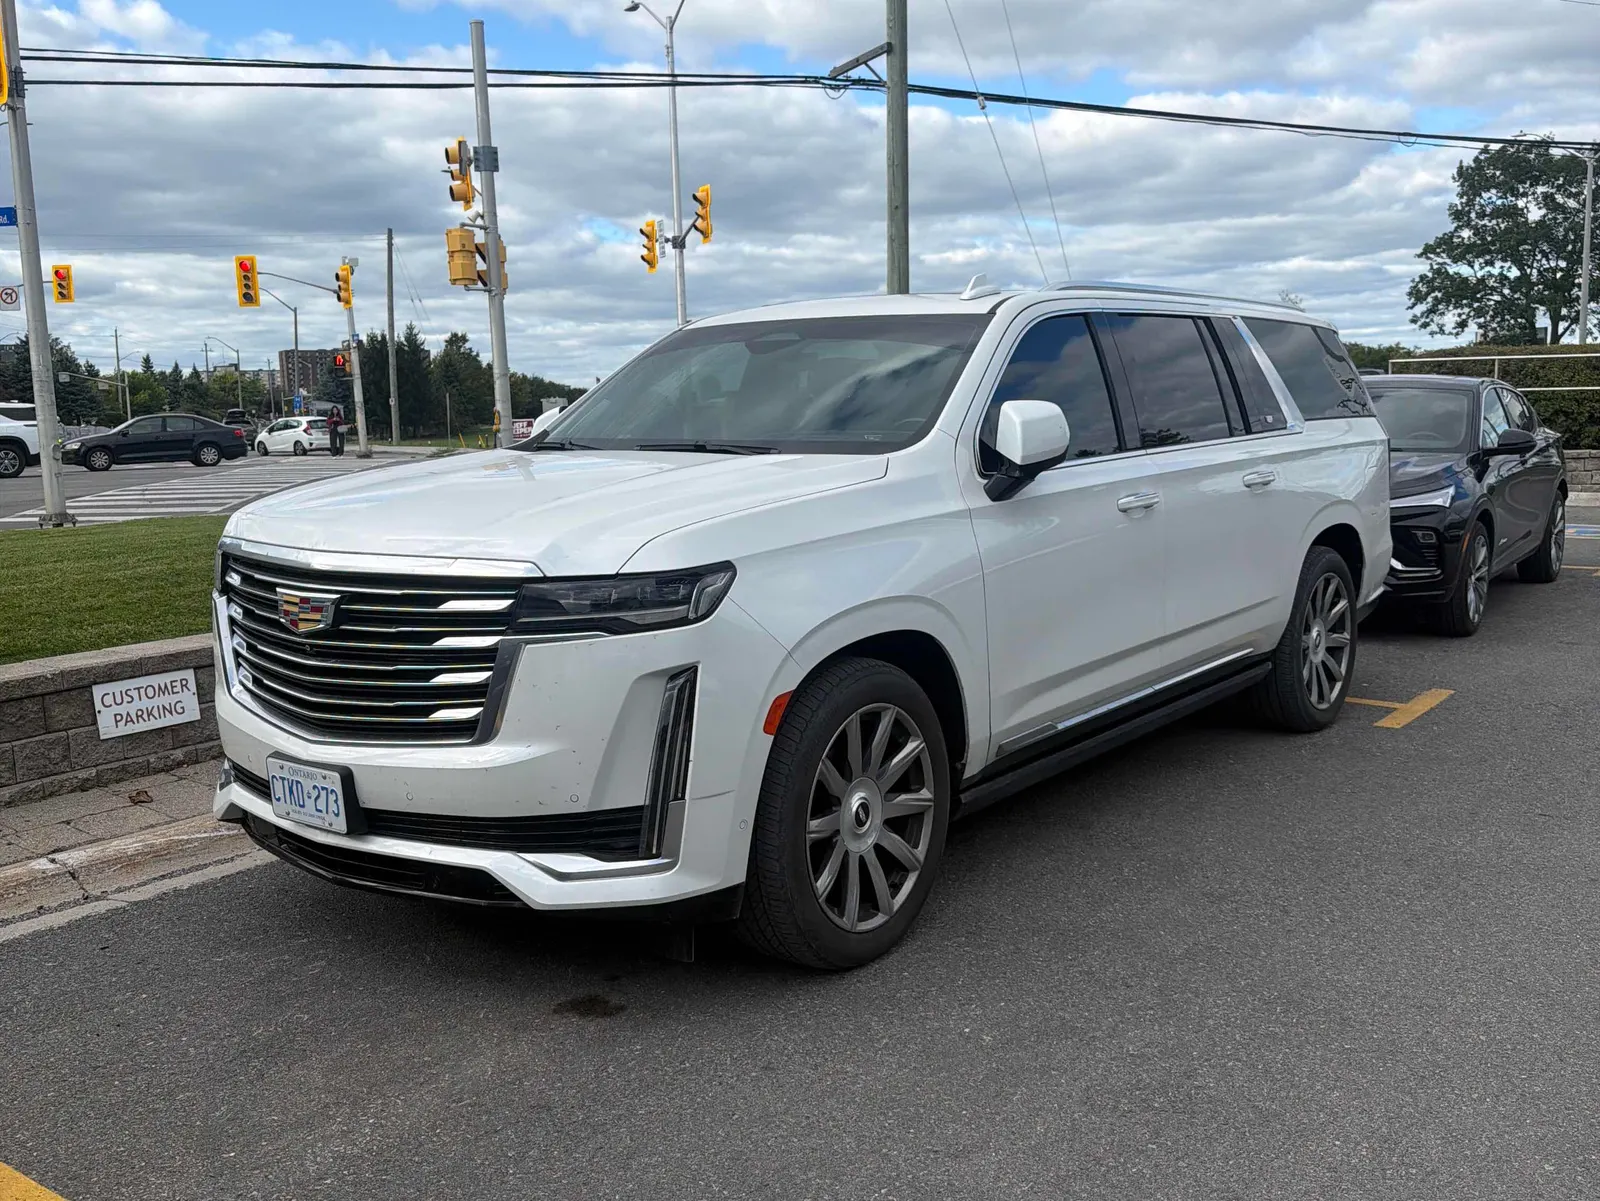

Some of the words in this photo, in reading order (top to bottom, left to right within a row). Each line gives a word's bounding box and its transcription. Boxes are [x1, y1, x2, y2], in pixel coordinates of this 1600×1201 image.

[101, 678, 191, 708] CUSTOMER
[113, 700, 185, 728] PARKING
[288, 766, 318, 781] ONTARIO
[312, 784, 340, 818] 273
